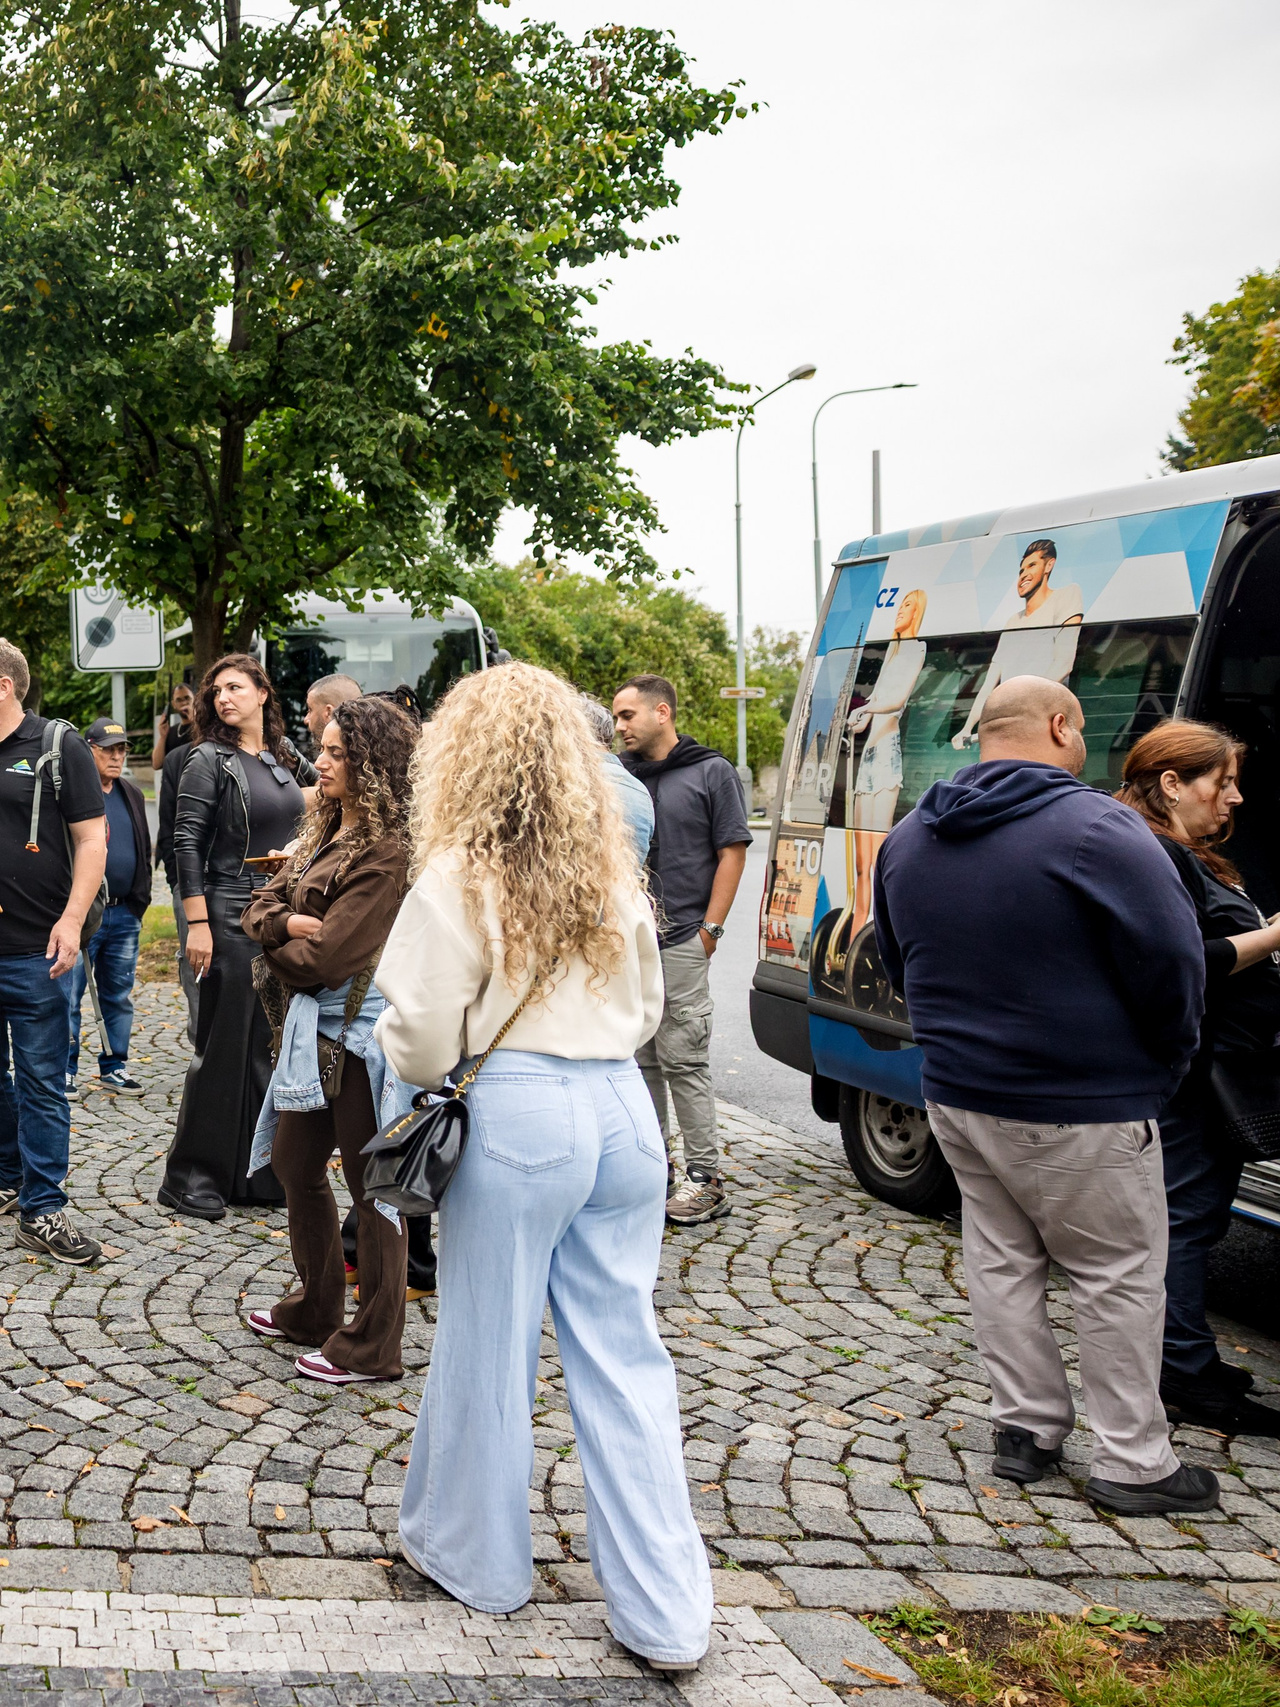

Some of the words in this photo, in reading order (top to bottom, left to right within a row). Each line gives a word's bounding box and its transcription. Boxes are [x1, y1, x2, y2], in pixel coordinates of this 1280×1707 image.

[876, 587, 900, 608] CZ
[794, 838, 821, 875] TO
[38, 1223, 60, 1243] N
